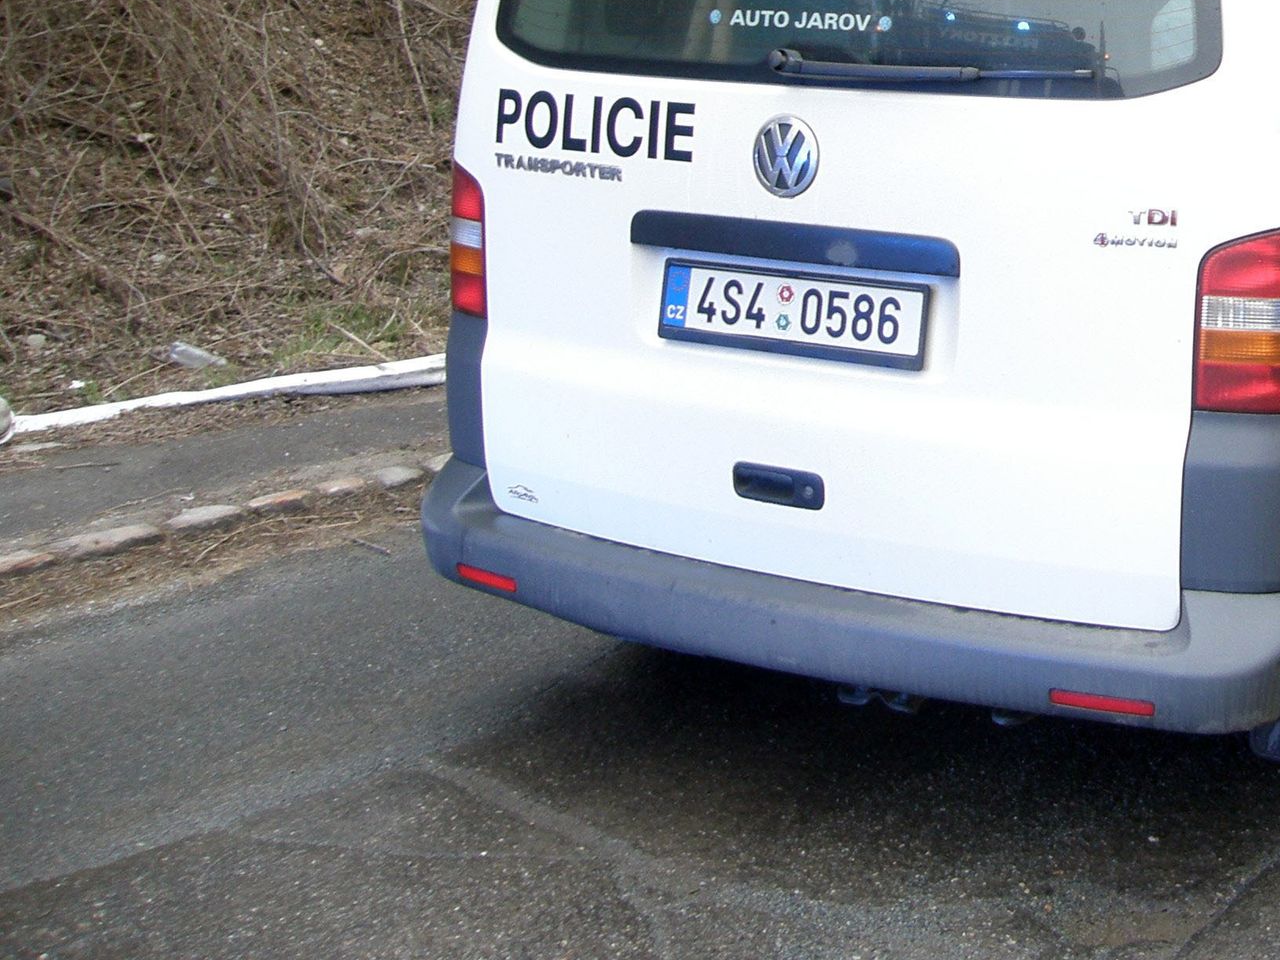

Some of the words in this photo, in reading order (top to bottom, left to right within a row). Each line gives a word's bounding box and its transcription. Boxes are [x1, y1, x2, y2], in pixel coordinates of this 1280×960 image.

[729, 9, 790, 28] AUTO
[794, 11, 872, 31] JAROV
[495, 88, 696, 163] POLICIE
[494, 152, 623, 182] TRANSPORTER
[1127, 209, 1177, 226] TDI
[666, 304, 685, 320] CZ
[696, 276, 766, 330] 4S4
[800, 287, 902, 345] 0586
